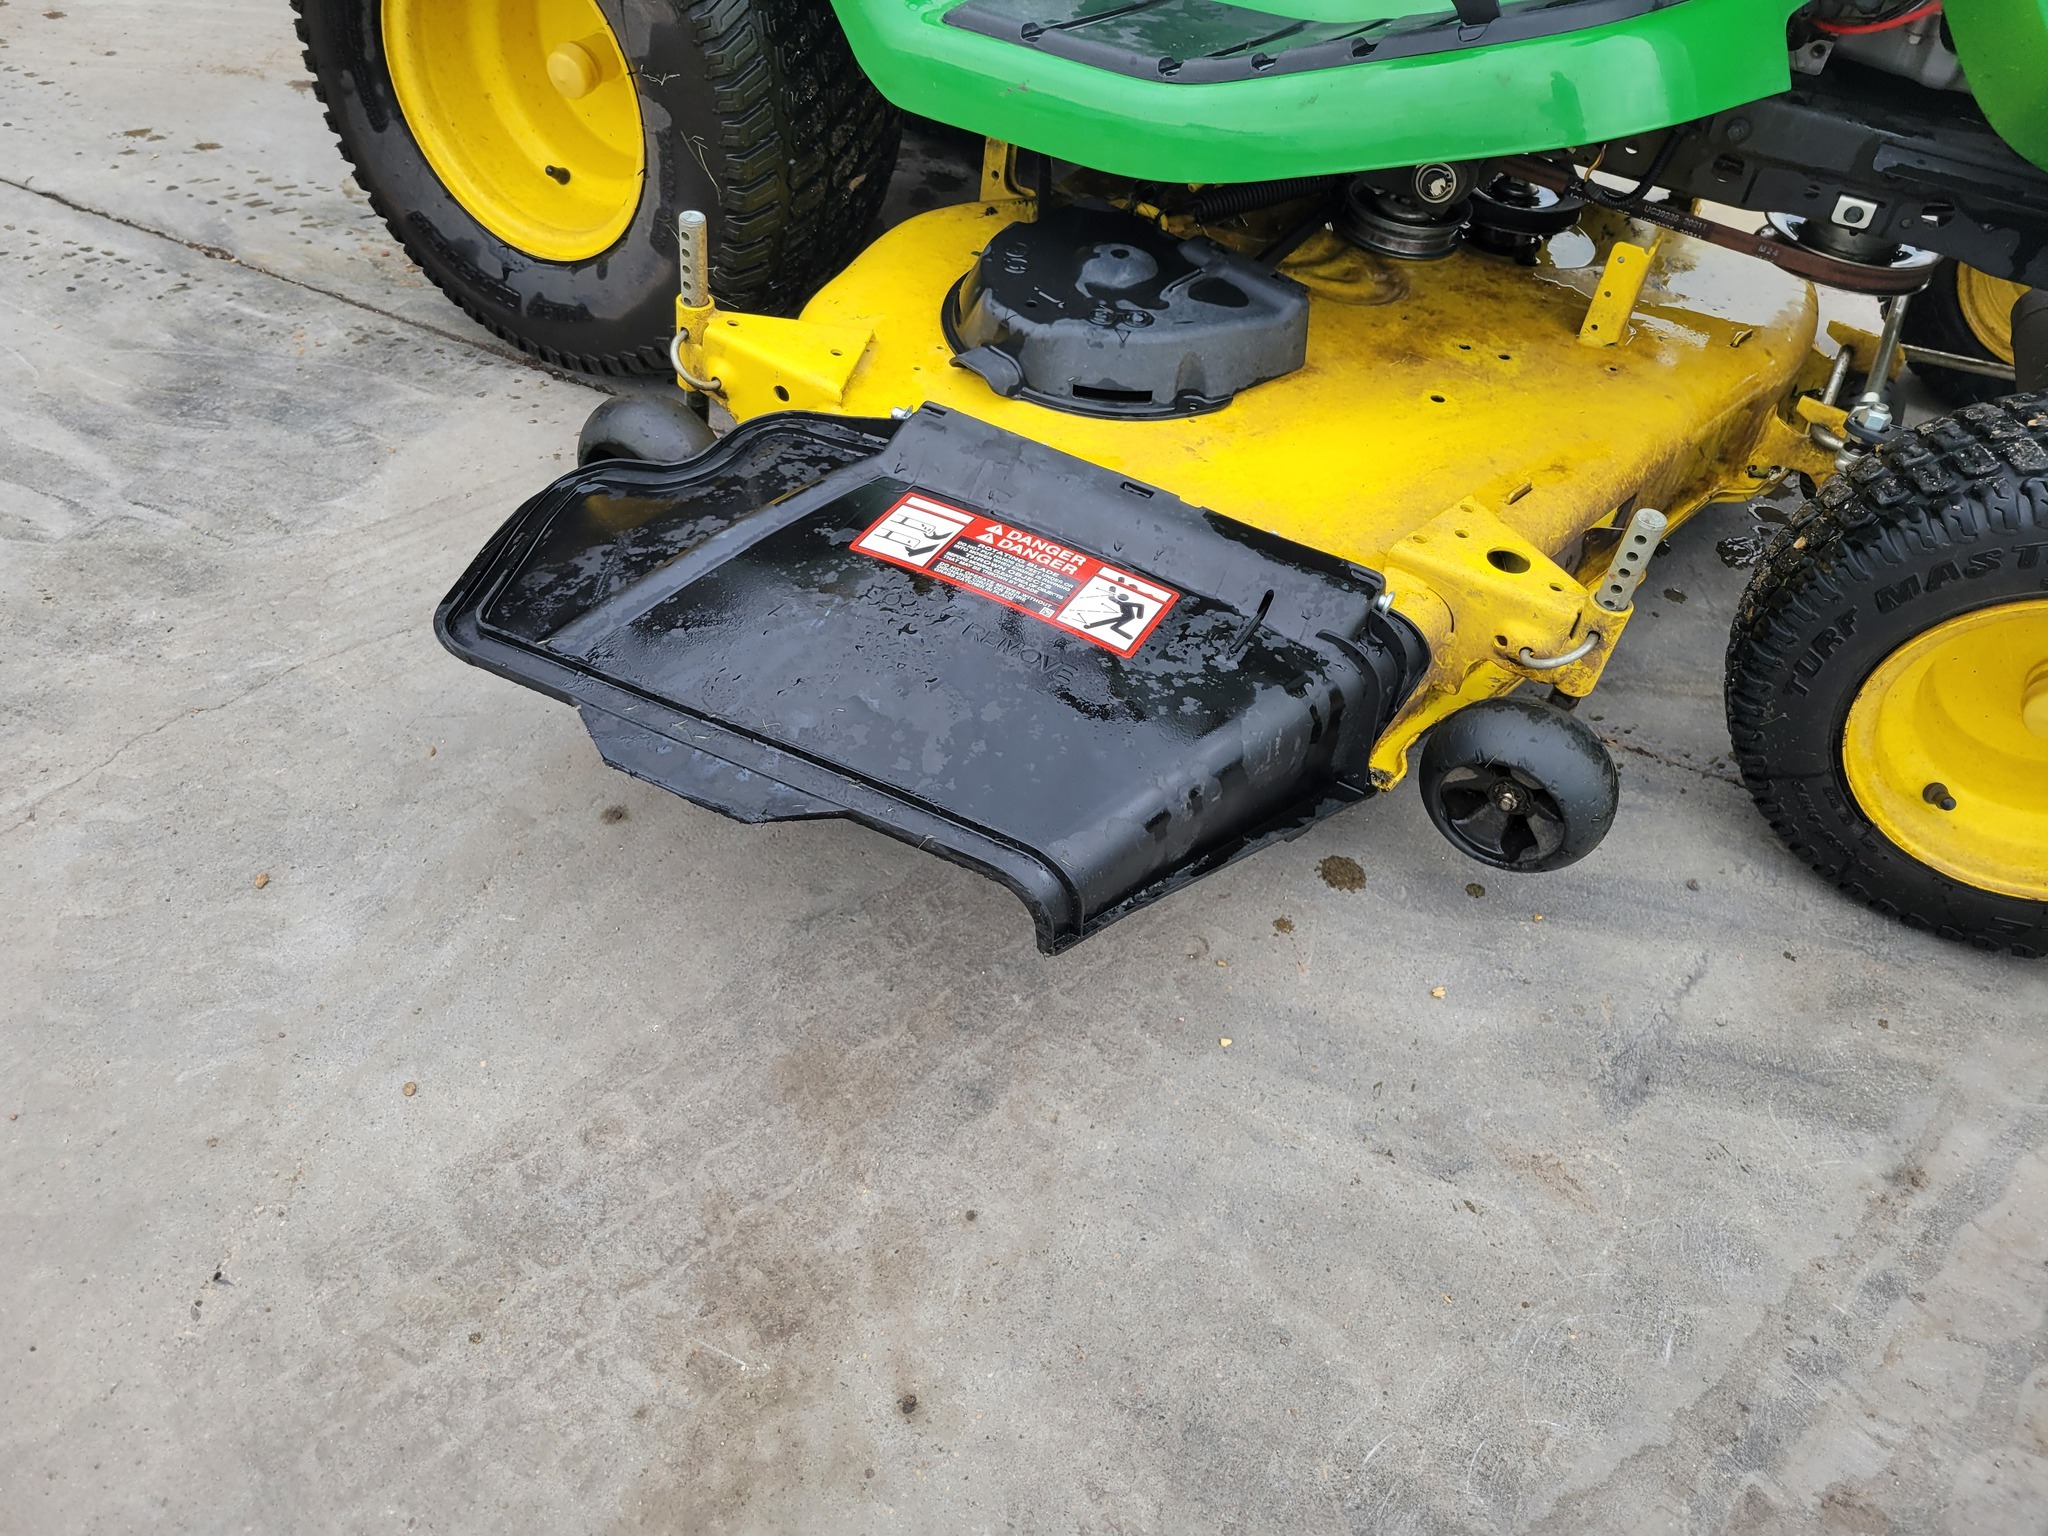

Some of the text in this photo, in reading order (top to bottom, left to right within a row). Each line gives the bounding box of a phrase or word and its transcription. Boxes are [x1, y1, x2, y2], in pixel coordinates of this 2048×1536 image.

[945, 550, 969, 562] BEFORE
[977, 543, 1060, 577] ROTATING BLADE
[997, 539, 1078, 575] DANGER
[1006, 530, 1087, 566] DANGER
[941, 554, 959, 563] THAT
[958, 560, 972, 568] MAY
[981, 568, 1008, 581] THROWN
[1016, 582, 1039, 594] BLADE
[952, 543, 969, 551] INTO
[967, 549, 993, 561] MOWER
[991, 558, 1011, 568] WHEN
[1010, 565, 1035, 577] ENGINE
[1041, 577, 1071, 591] RUNNING
[963, 552, 1052, 589] THROWN OBJECTS
[992, 553, 1015, 564] HANDS
[1024, 566, 1041, 575] FEET
[1040, 573, 1063, 584] UNDER
[949, 565, 964, 573] NOT
[1020, 592, 1052, 608] WITHOUT
[1783, 541, 2048, 697] TURF MAST
